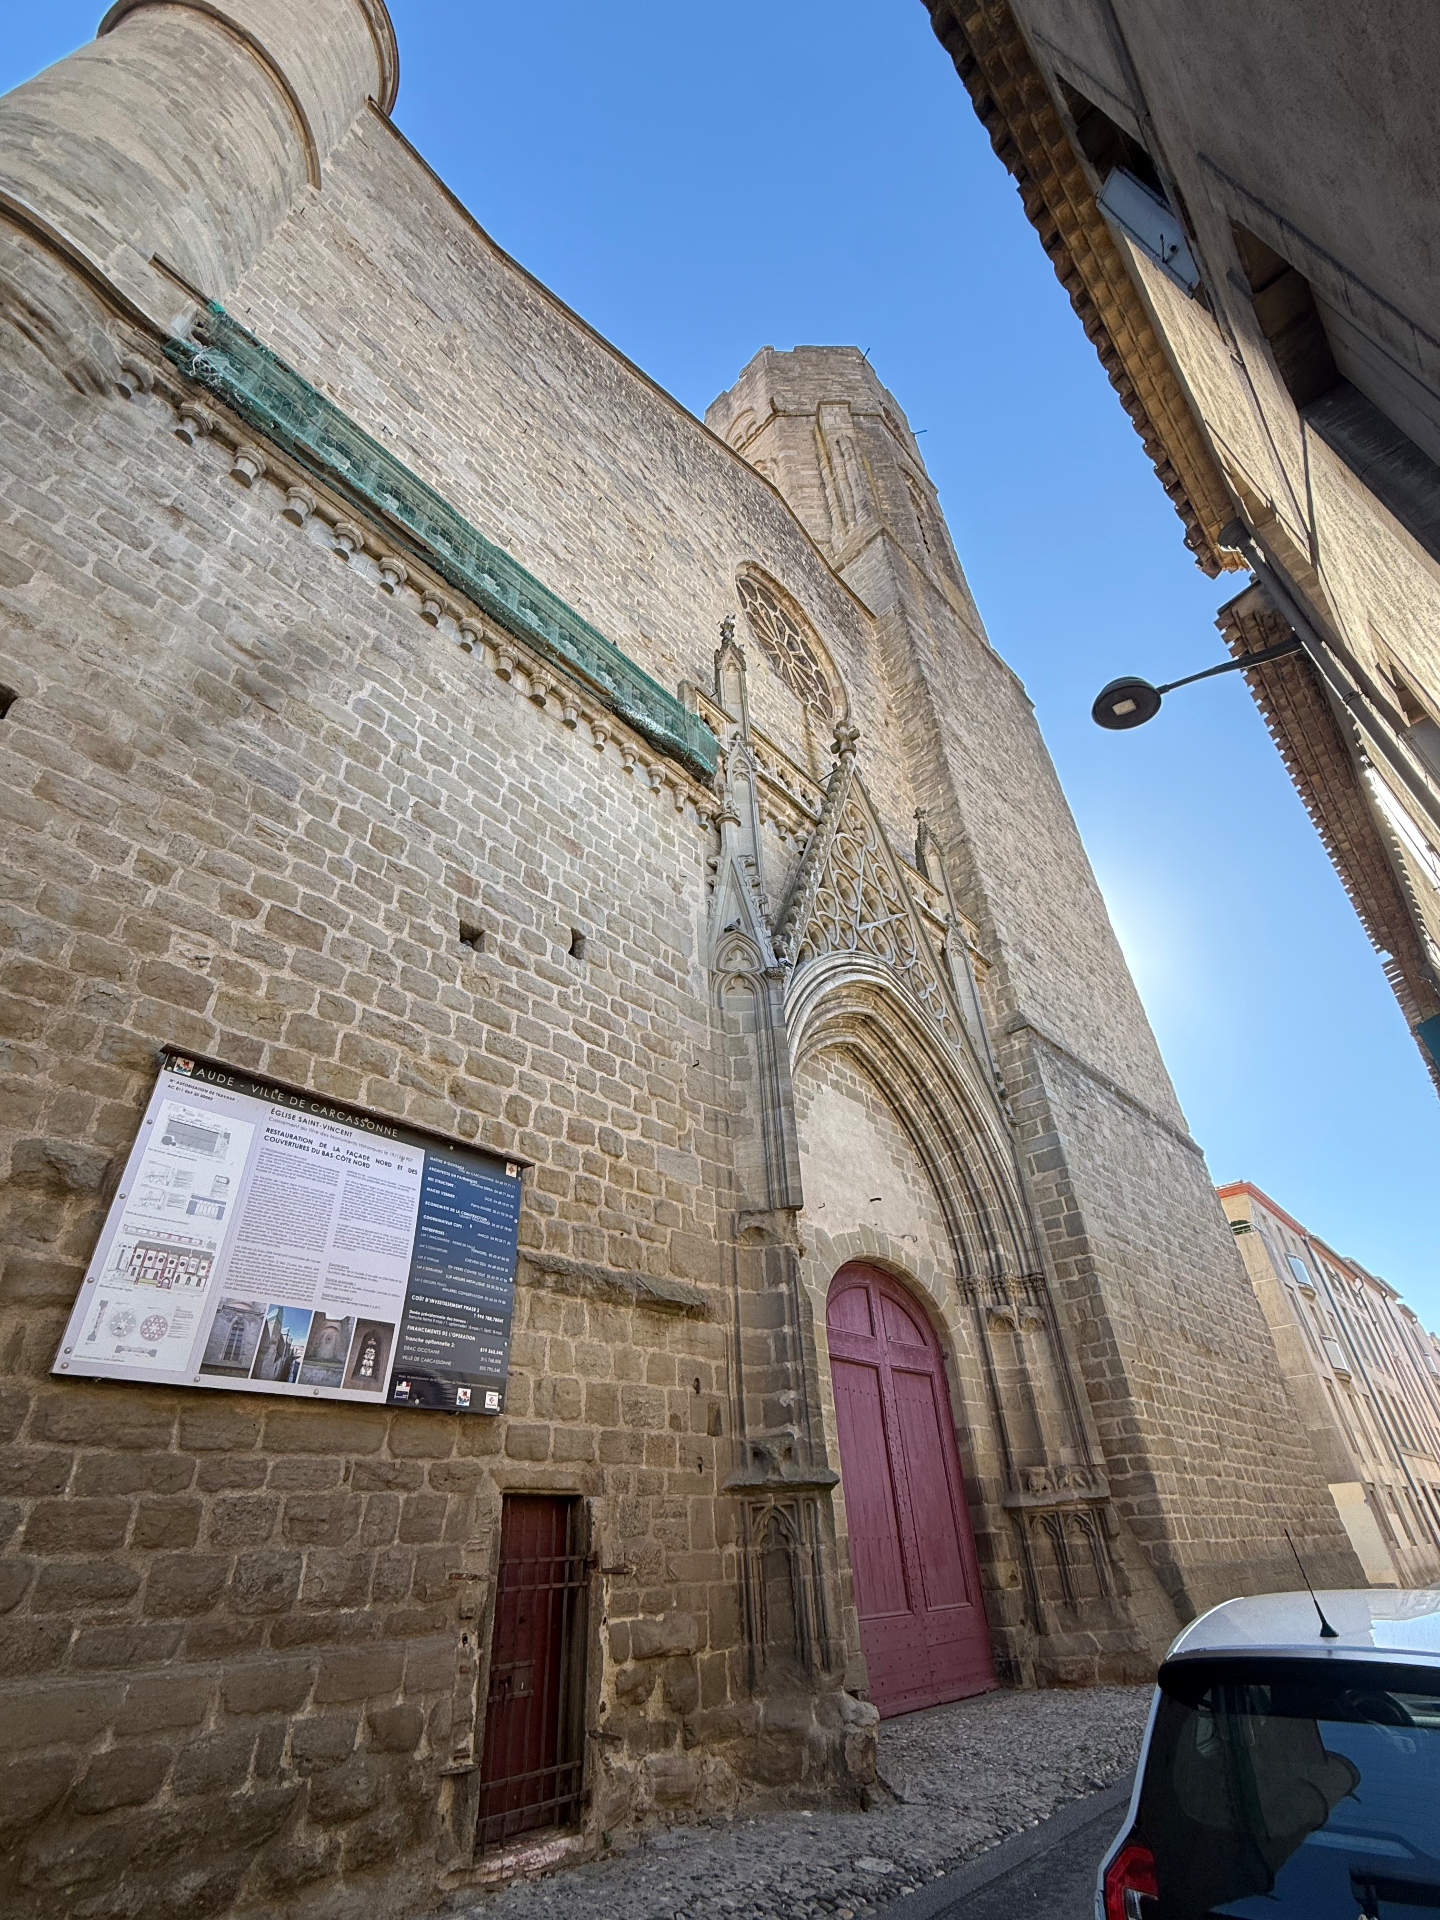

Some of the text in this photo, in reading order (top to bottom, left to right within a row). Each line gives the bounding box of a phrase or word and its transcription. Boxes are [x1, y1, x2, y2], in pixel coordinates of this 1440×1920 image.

[195, 1067, 235, 1086] AUDE
[250, 1083, 285, 1102] VILLE
[289, 1095, 305, 1108] DE
[309, 1102, 398, 1137] CARCASSONNE
[270, 1106, 352, 1137] ÉGLISE SAINT-VINCENT
[263, 1133, 310, 1152] COUVERTURES
[310, 1146, 320, 1154] DU
[352, 1158, 370, 1168] NORD
[265, 1126, 313, 1145] RESTAURATION
[318, 1141, 327, 1149] DE
[345, 1149, 370, 1162] FAÇADE
[375, 1157, 392, 1167] NORD
[407, 1167, 418, 1175] DES
[329, 1134, 357, 1146] Monuments
